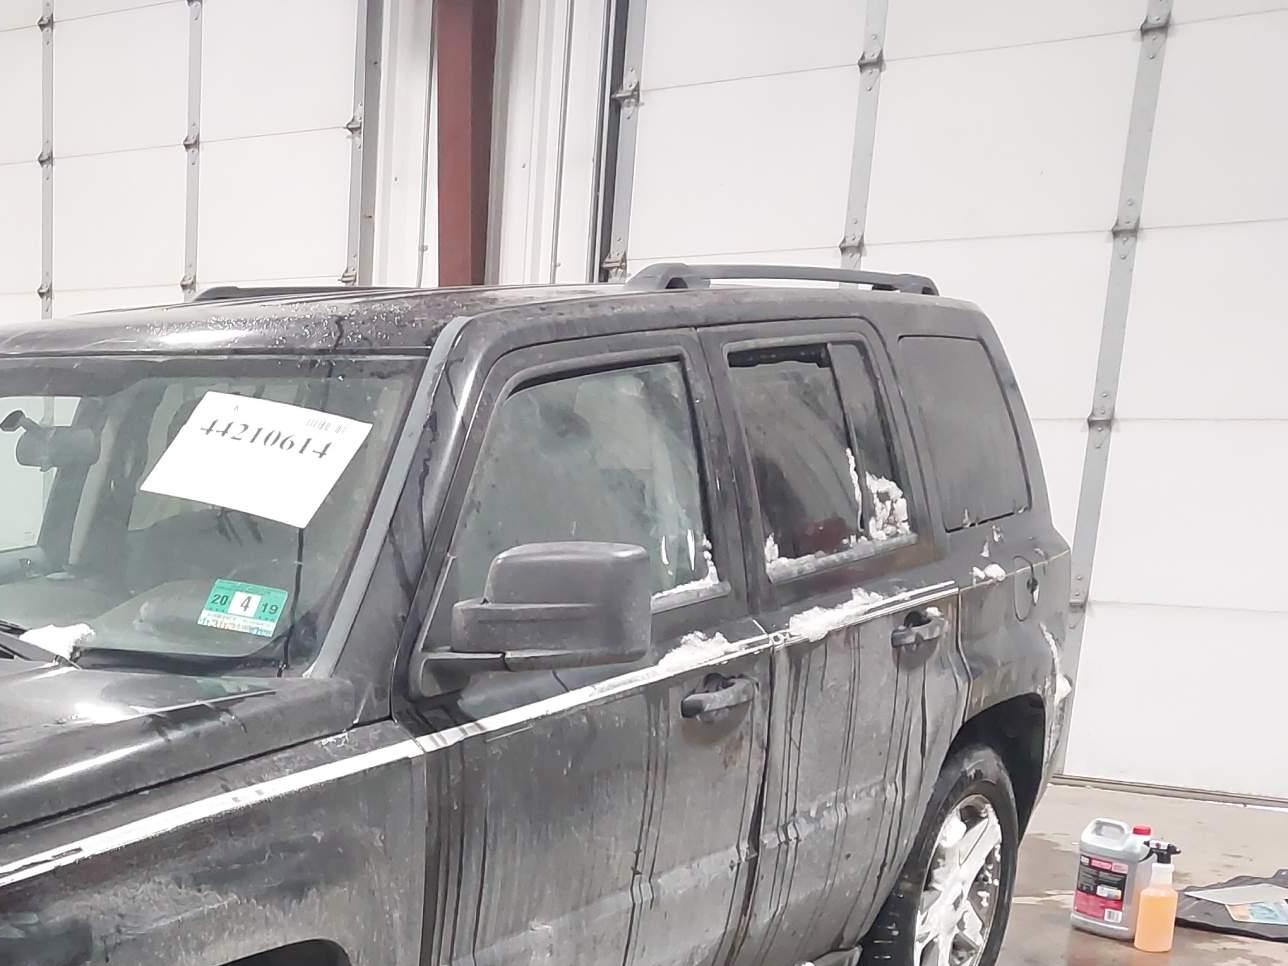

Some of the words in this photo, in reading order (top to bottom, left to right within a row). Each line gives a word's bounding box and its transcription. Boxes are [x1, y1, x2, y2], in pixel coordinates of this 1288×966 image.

[199, 418, 333, 460] 44210614
[212, 593, 229, 607] 20
[240, 595, 252, 612] 4
[261, 602, 279, 615] 19
